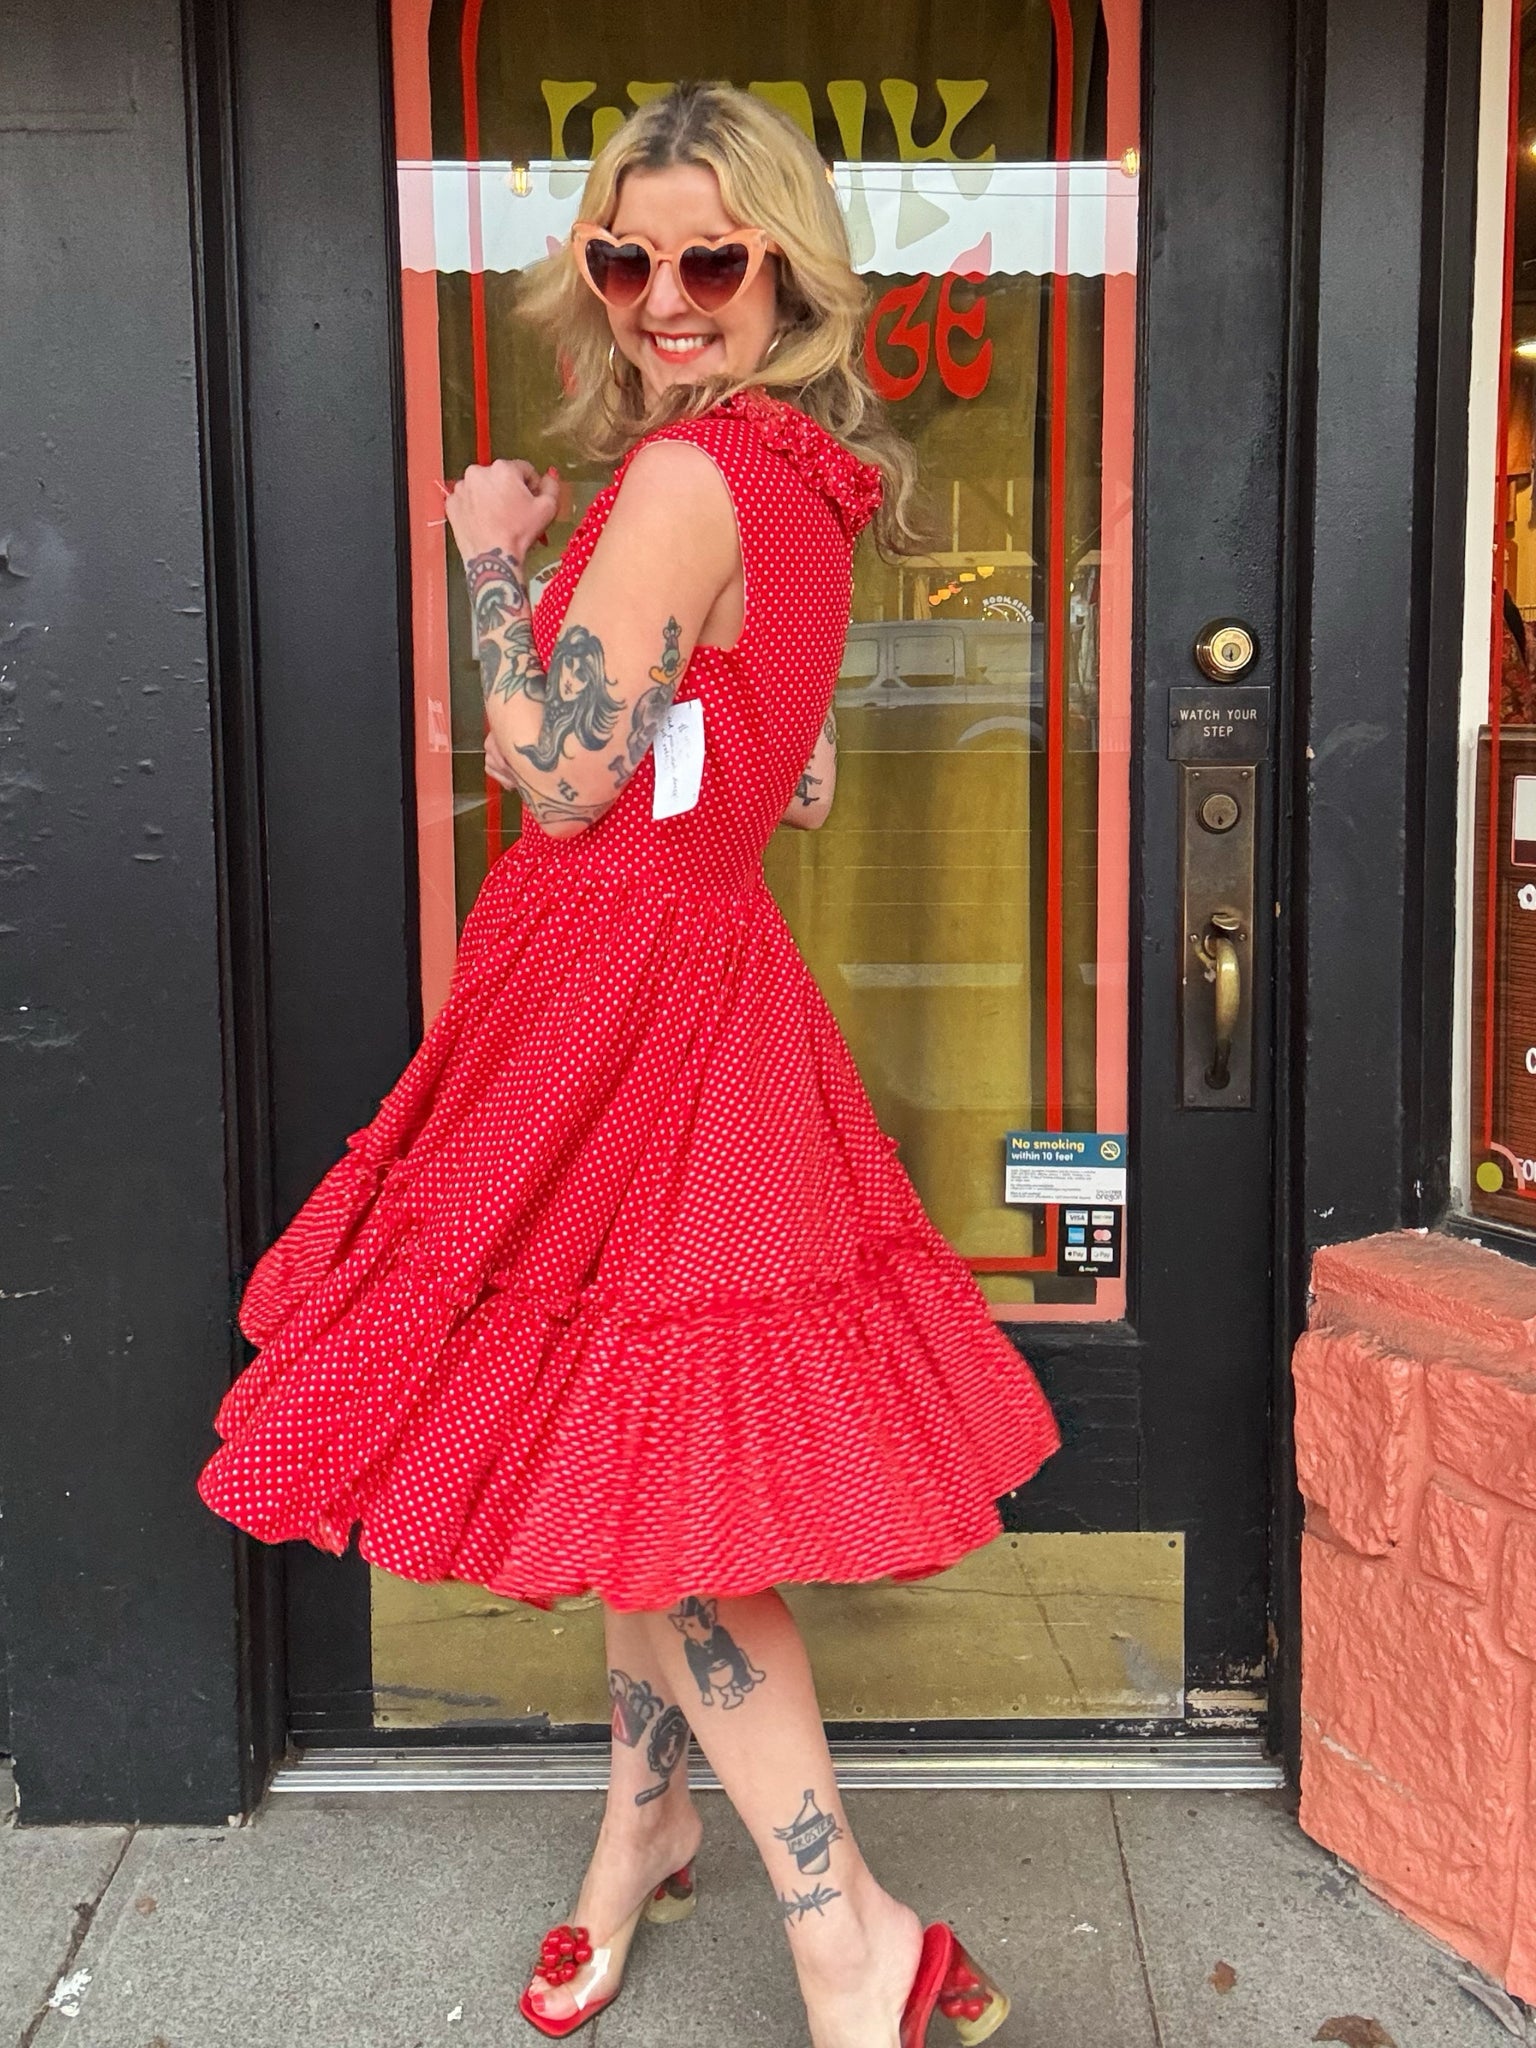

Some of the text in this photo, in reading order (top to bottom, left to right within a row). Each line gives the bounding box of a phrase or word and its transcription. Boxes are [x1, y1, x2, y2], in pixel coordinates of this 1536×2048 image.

[1180, 708, 1258, 721] WATCH YOUR
[1203, 725, 1234, 737] STEP
[1012, 1137, 1085, 1153] No smoking
[1011, 1151, 1074, 1161] within 10 feet
